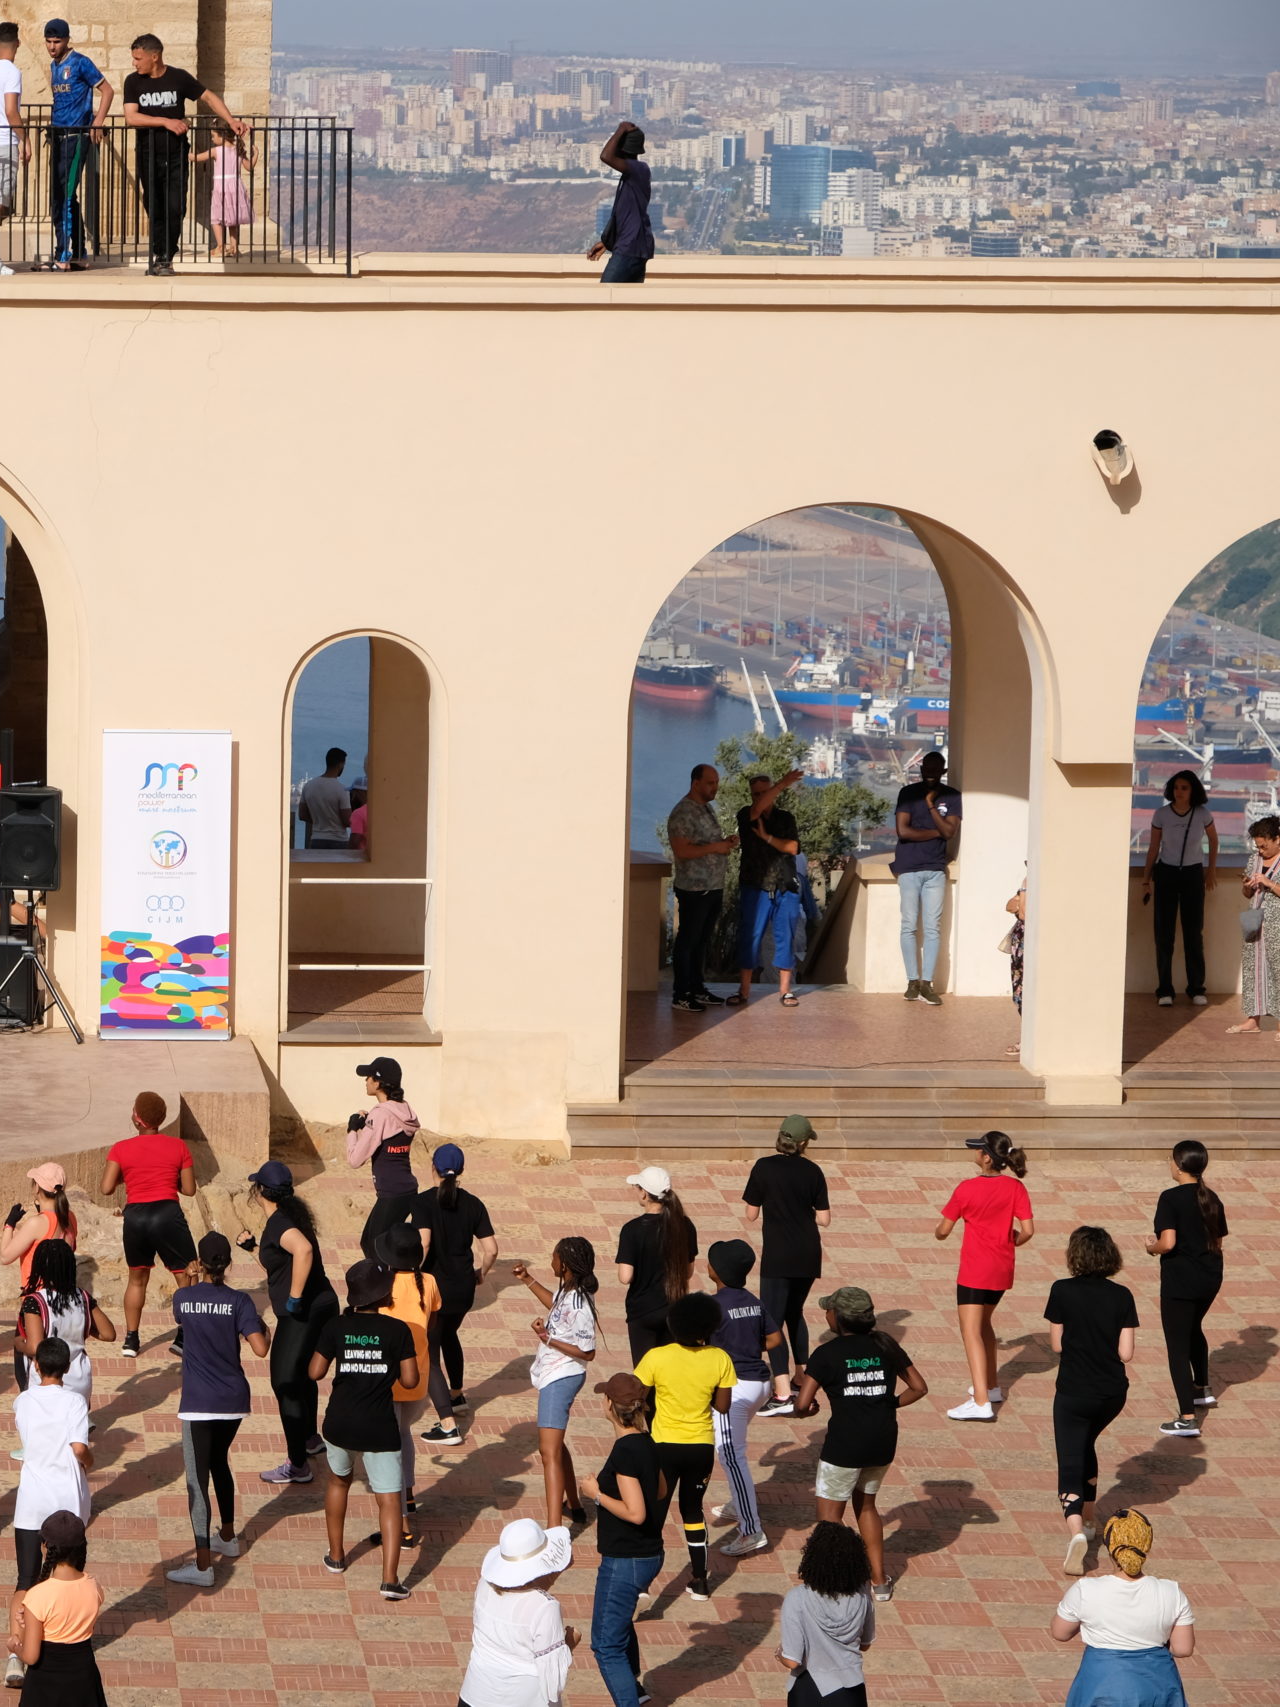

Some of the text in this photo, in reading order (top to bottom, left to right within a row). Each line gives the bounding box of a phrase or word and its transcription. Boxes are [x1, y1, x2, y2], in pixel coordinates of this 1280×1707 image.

[180, 1301, 233, 1316] VOLONTAIRE
[344, 1334, 380, 1346] ZIM@42
[371, 1350, 383, 1360] ONE
